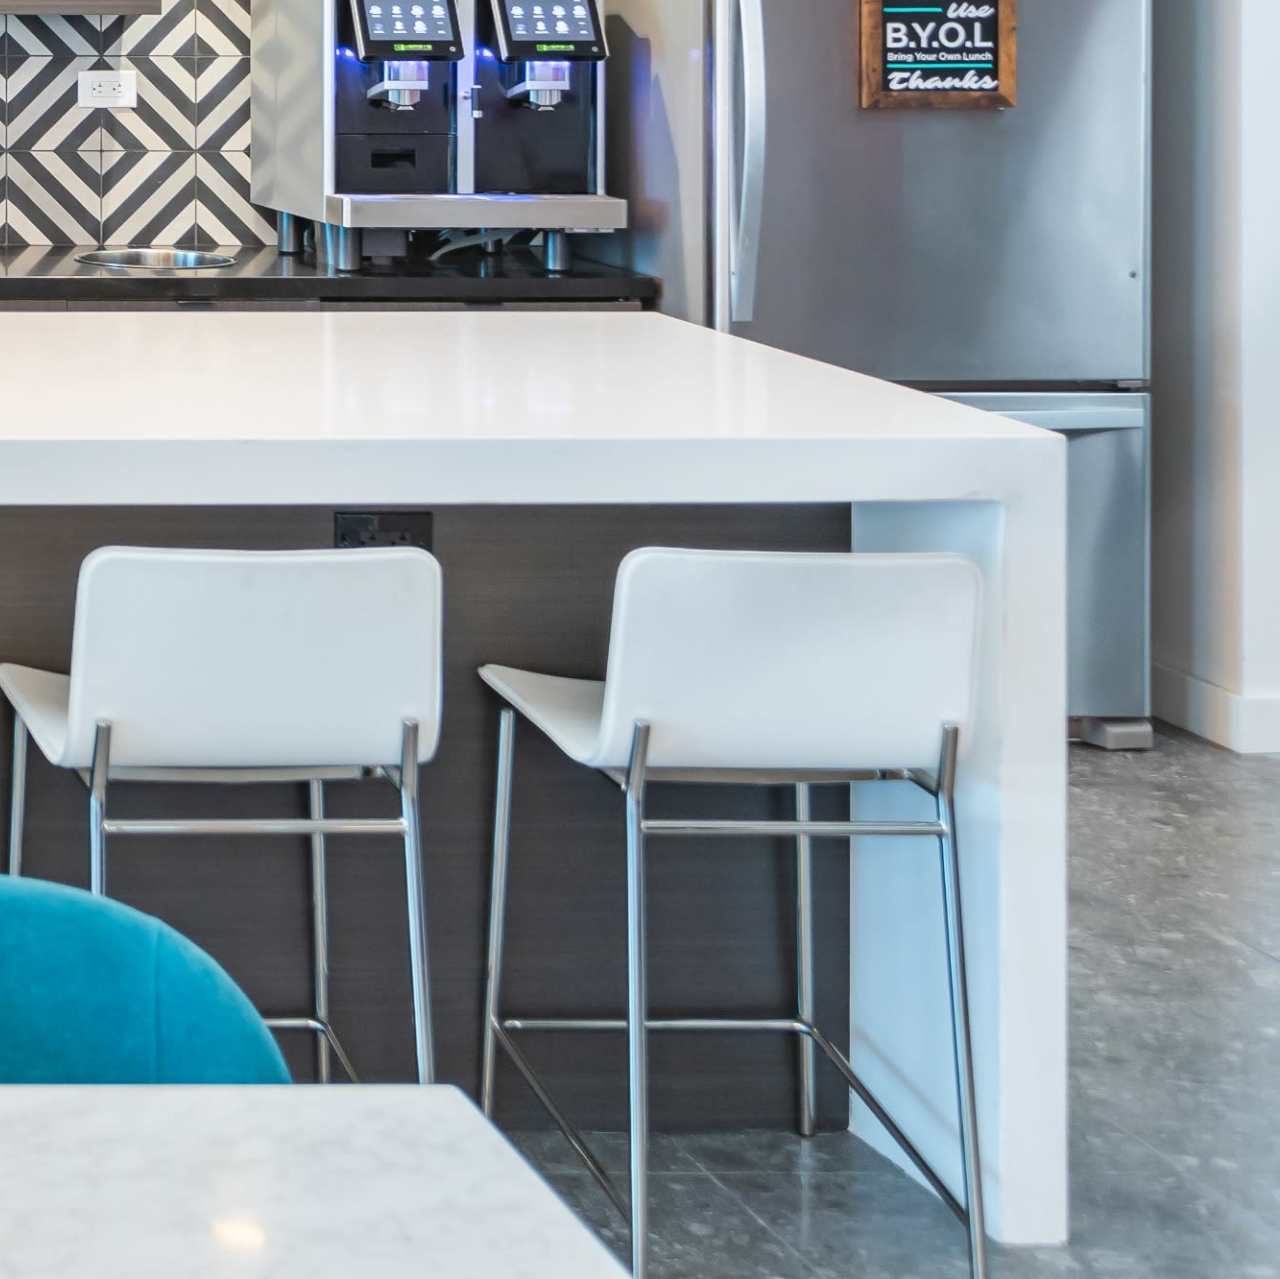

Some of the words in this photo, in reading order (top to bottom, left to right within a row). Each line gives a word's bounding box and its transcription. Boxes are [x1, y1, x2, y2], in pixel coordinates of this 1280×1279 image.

[946, 2, 995, 19] Use
[885, 22, 994, 49] B.Y.O.L
[887, 52, 914, 63] Bring
[914, 52, 937, 61] Your
[938, 52, 961, 61] Own
[962, 52, 993, 61] Lunch
[888, 70, 999, 90] Thanks
